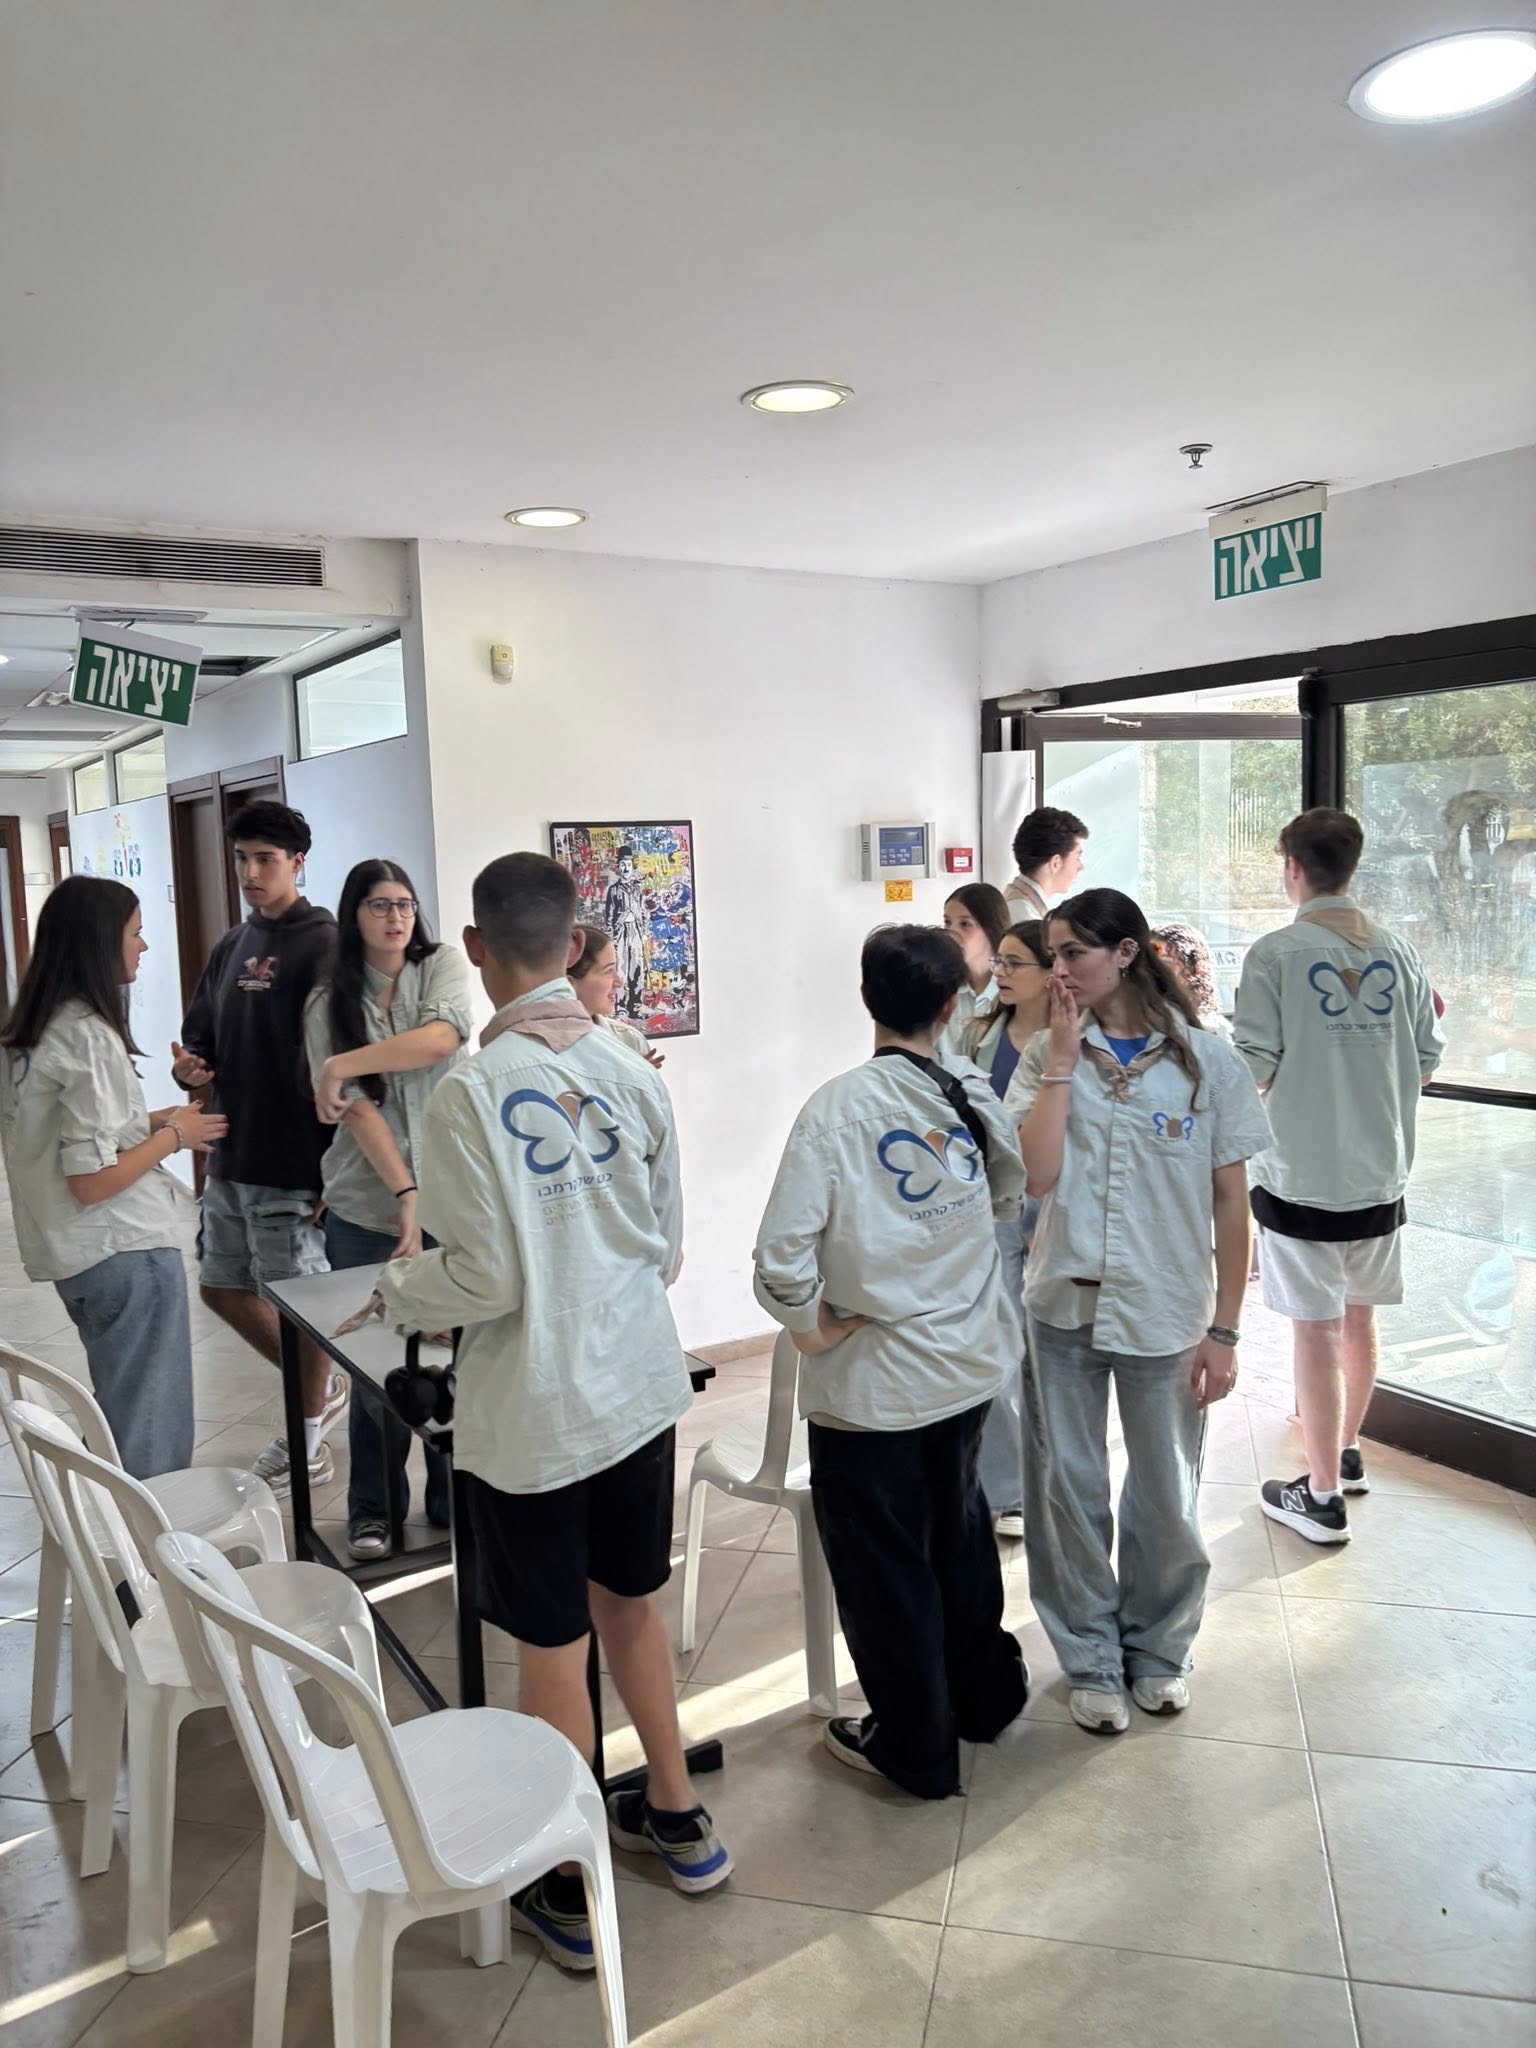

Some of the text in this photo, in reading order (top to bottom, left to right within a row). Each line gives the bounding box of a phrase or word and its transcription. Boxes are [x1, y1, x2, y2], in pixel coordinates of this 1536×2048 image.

[1219, 517, 1316, 597] יציאה
[85, 644, 182, 717] יציאה
[908, 1205, 948, 1221] קרמבו
[1280, 1490, 1307, 1512] N
